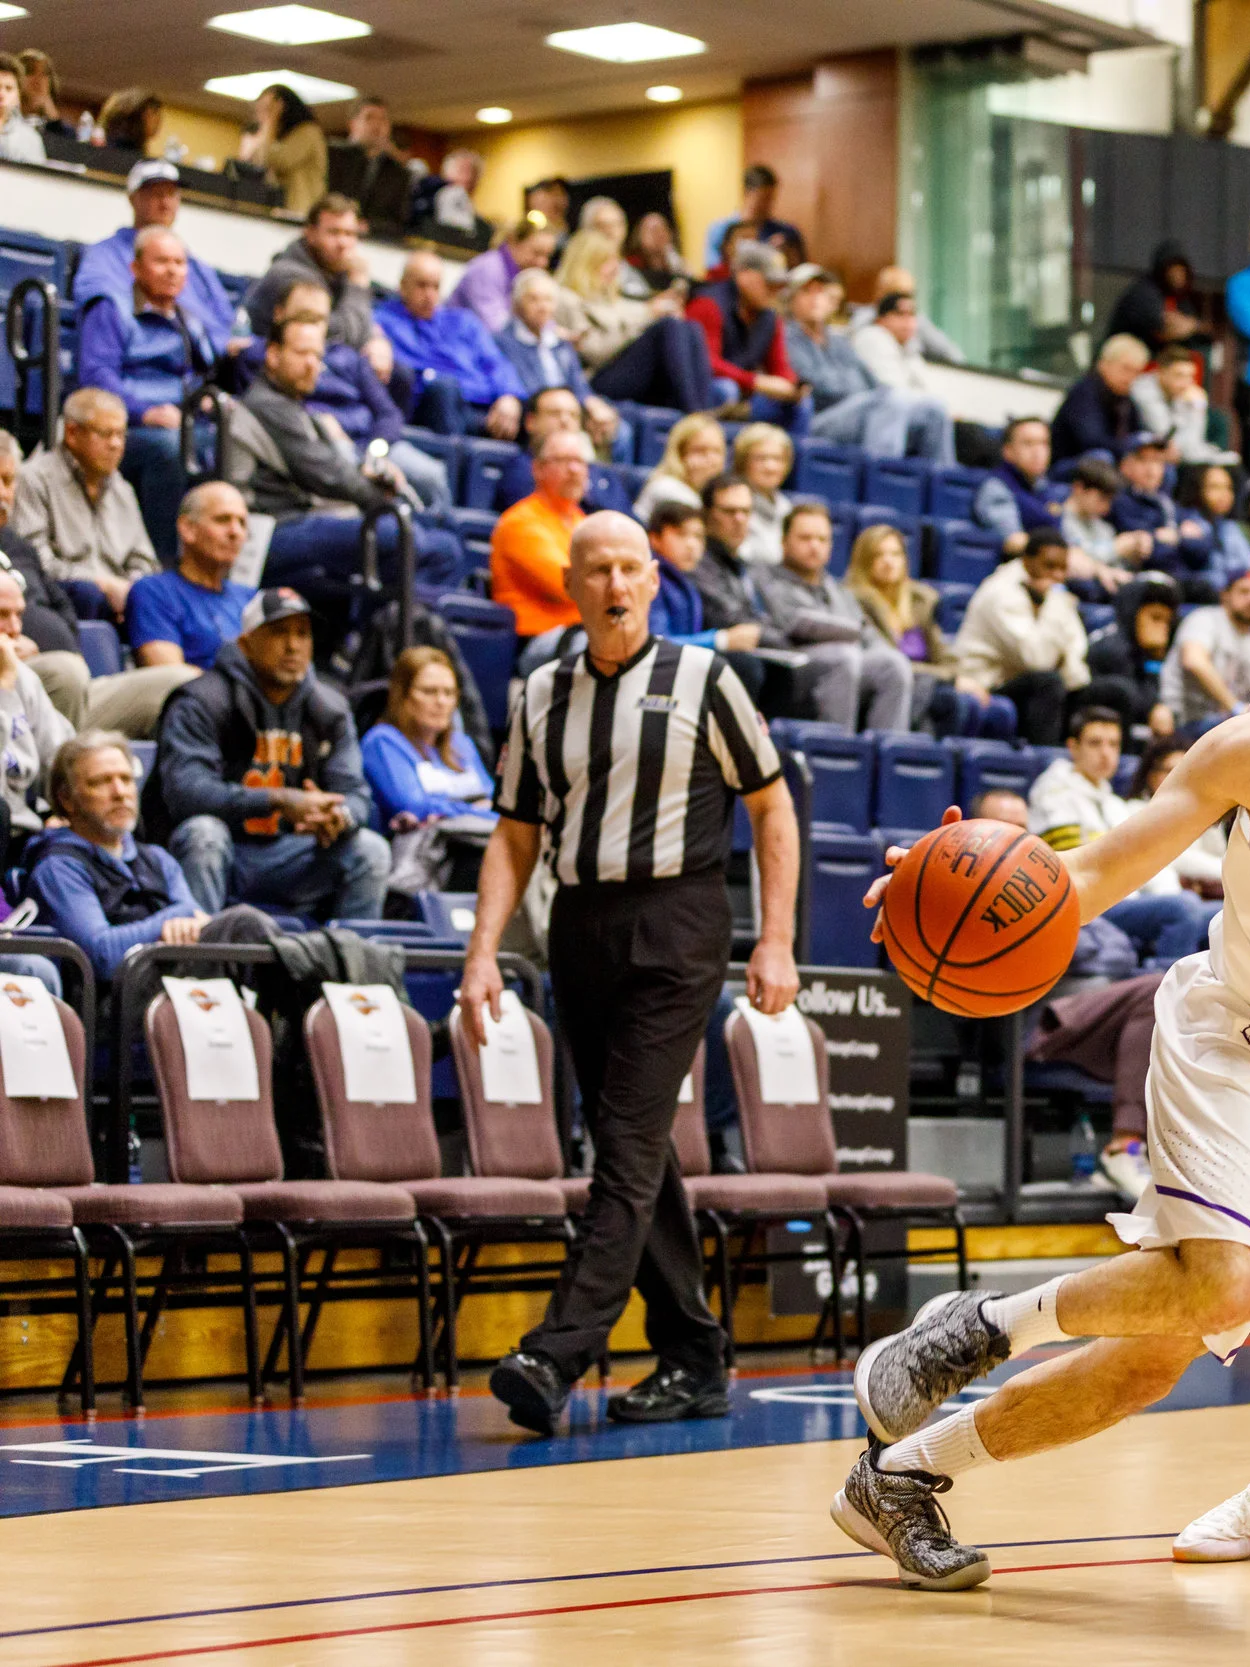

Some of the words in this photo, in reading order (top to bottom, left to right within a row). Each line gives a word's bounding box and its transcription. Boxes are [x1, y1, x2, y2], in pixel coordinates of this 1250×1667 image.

[1028, 846, 1061, 884] HE
[980, 866, 1047, 933] ROCK
[797, 982, 856, 1015] ollow
